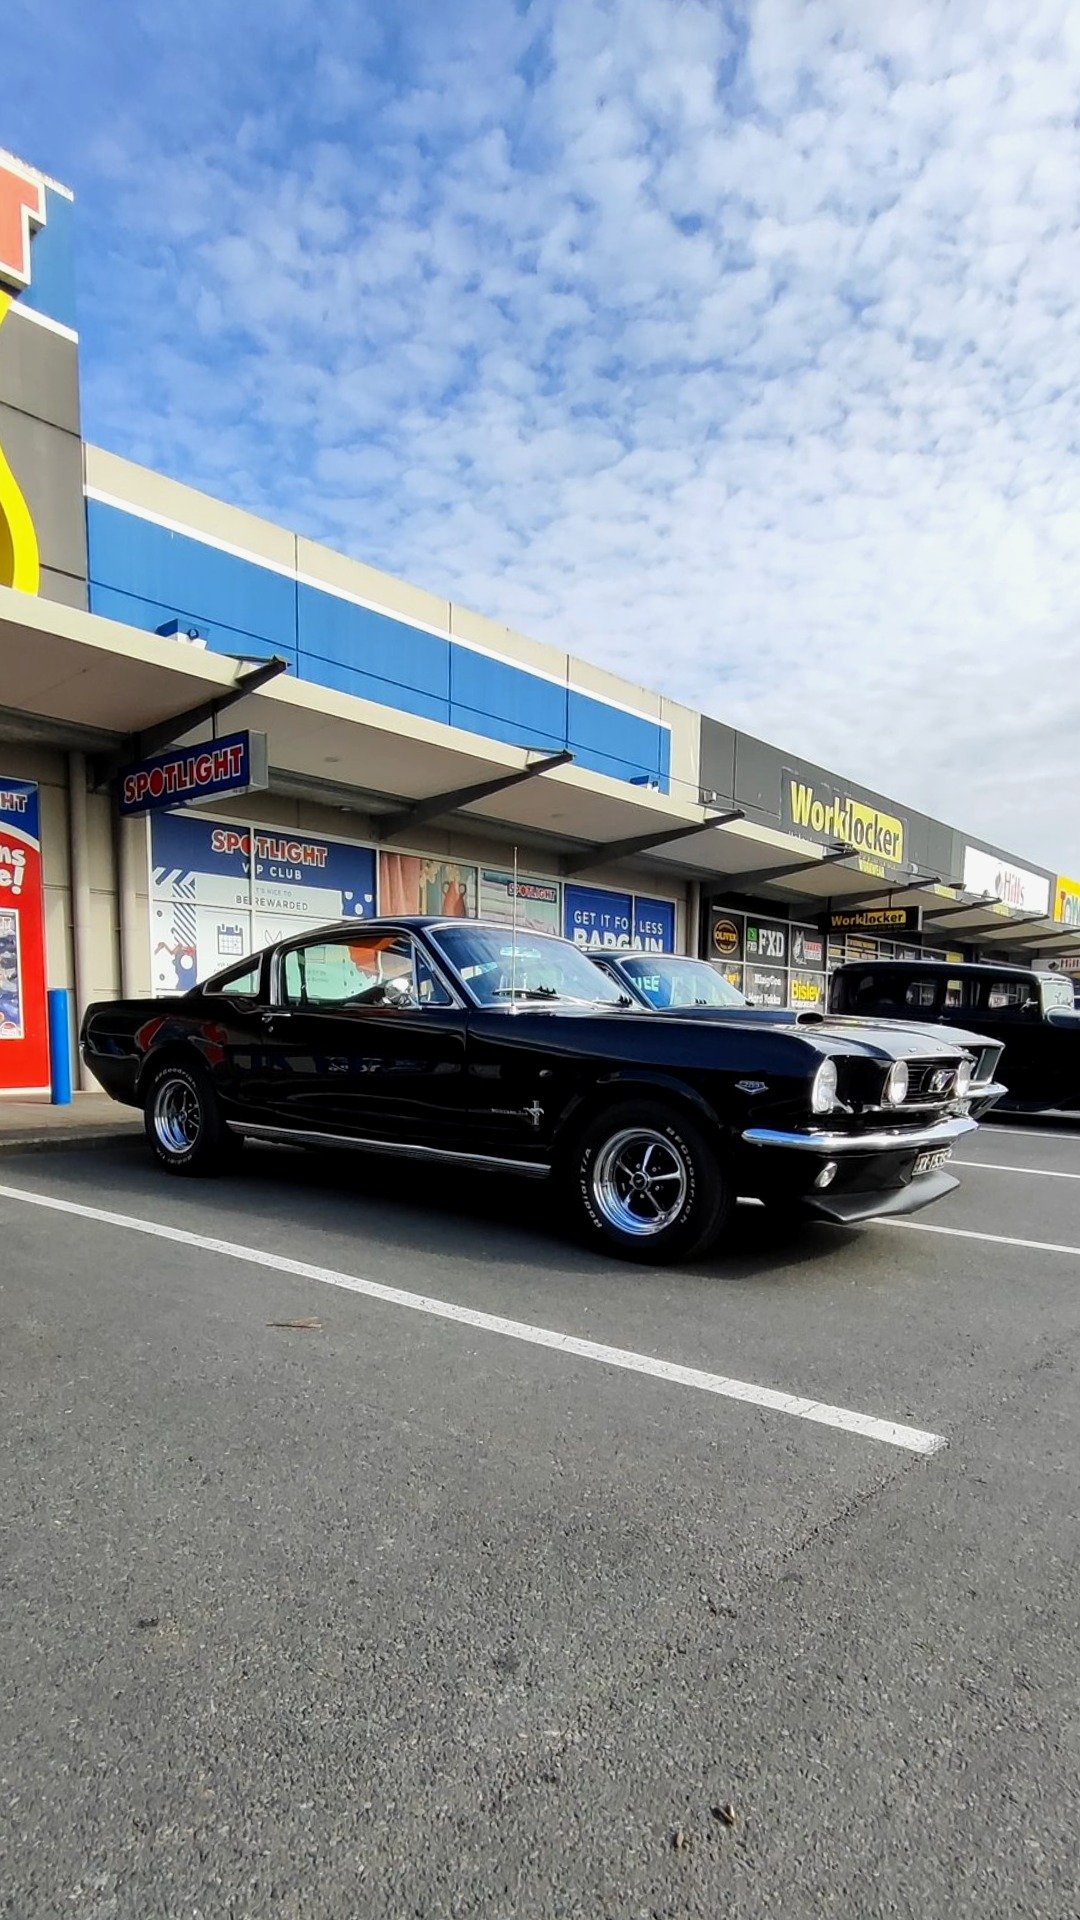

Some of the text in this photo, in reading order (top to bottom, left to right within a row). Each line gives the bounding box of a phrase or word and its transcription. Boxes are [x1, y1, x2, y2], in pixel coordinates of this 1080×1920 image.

[124, 743, 244, 804] SPOTLIGHT
[790, 780, 900, 858] Worklocker
[211, 829, 328, 868] SPOTLIGHT
[242, 862, 302, 880] VP CLUB
[236, 895, 250, 904] BE
[574, 910, 663, 935] GET IT FO LESS
[831, 911, 904, 927] Worklocker
[758, 928, 785, 957] FXD
[791, 979, 821, 1004] Bisley
